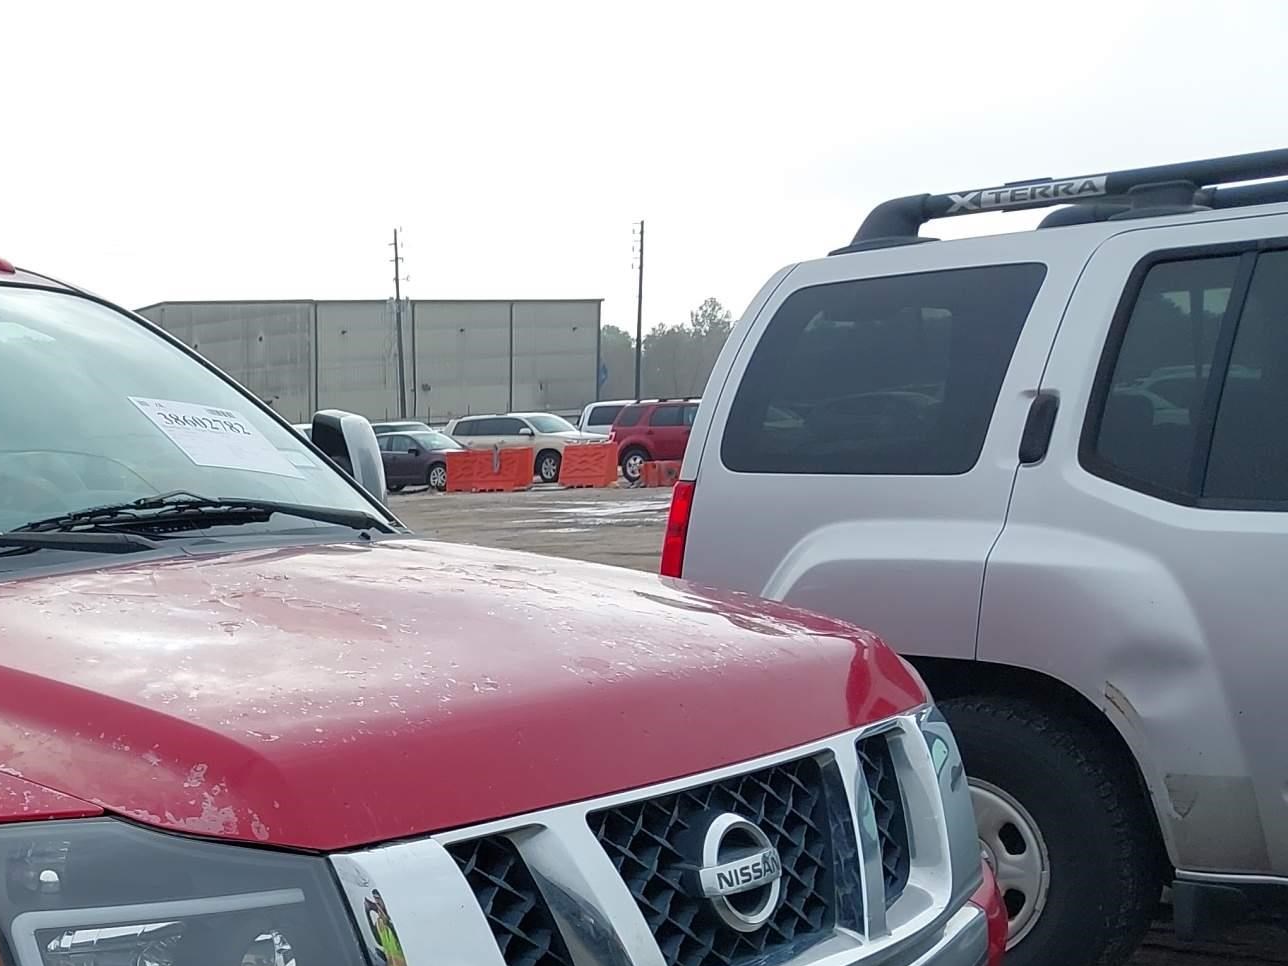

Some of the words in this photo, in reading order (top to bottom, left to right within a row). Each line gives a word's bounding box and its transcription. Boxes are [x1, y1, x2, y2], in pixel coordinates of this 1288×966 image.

[946, 177, 1101, 213] XTERRA
[156, 411, 252, 436] 38602782
[716, 856, 780, 890] NISSAN
